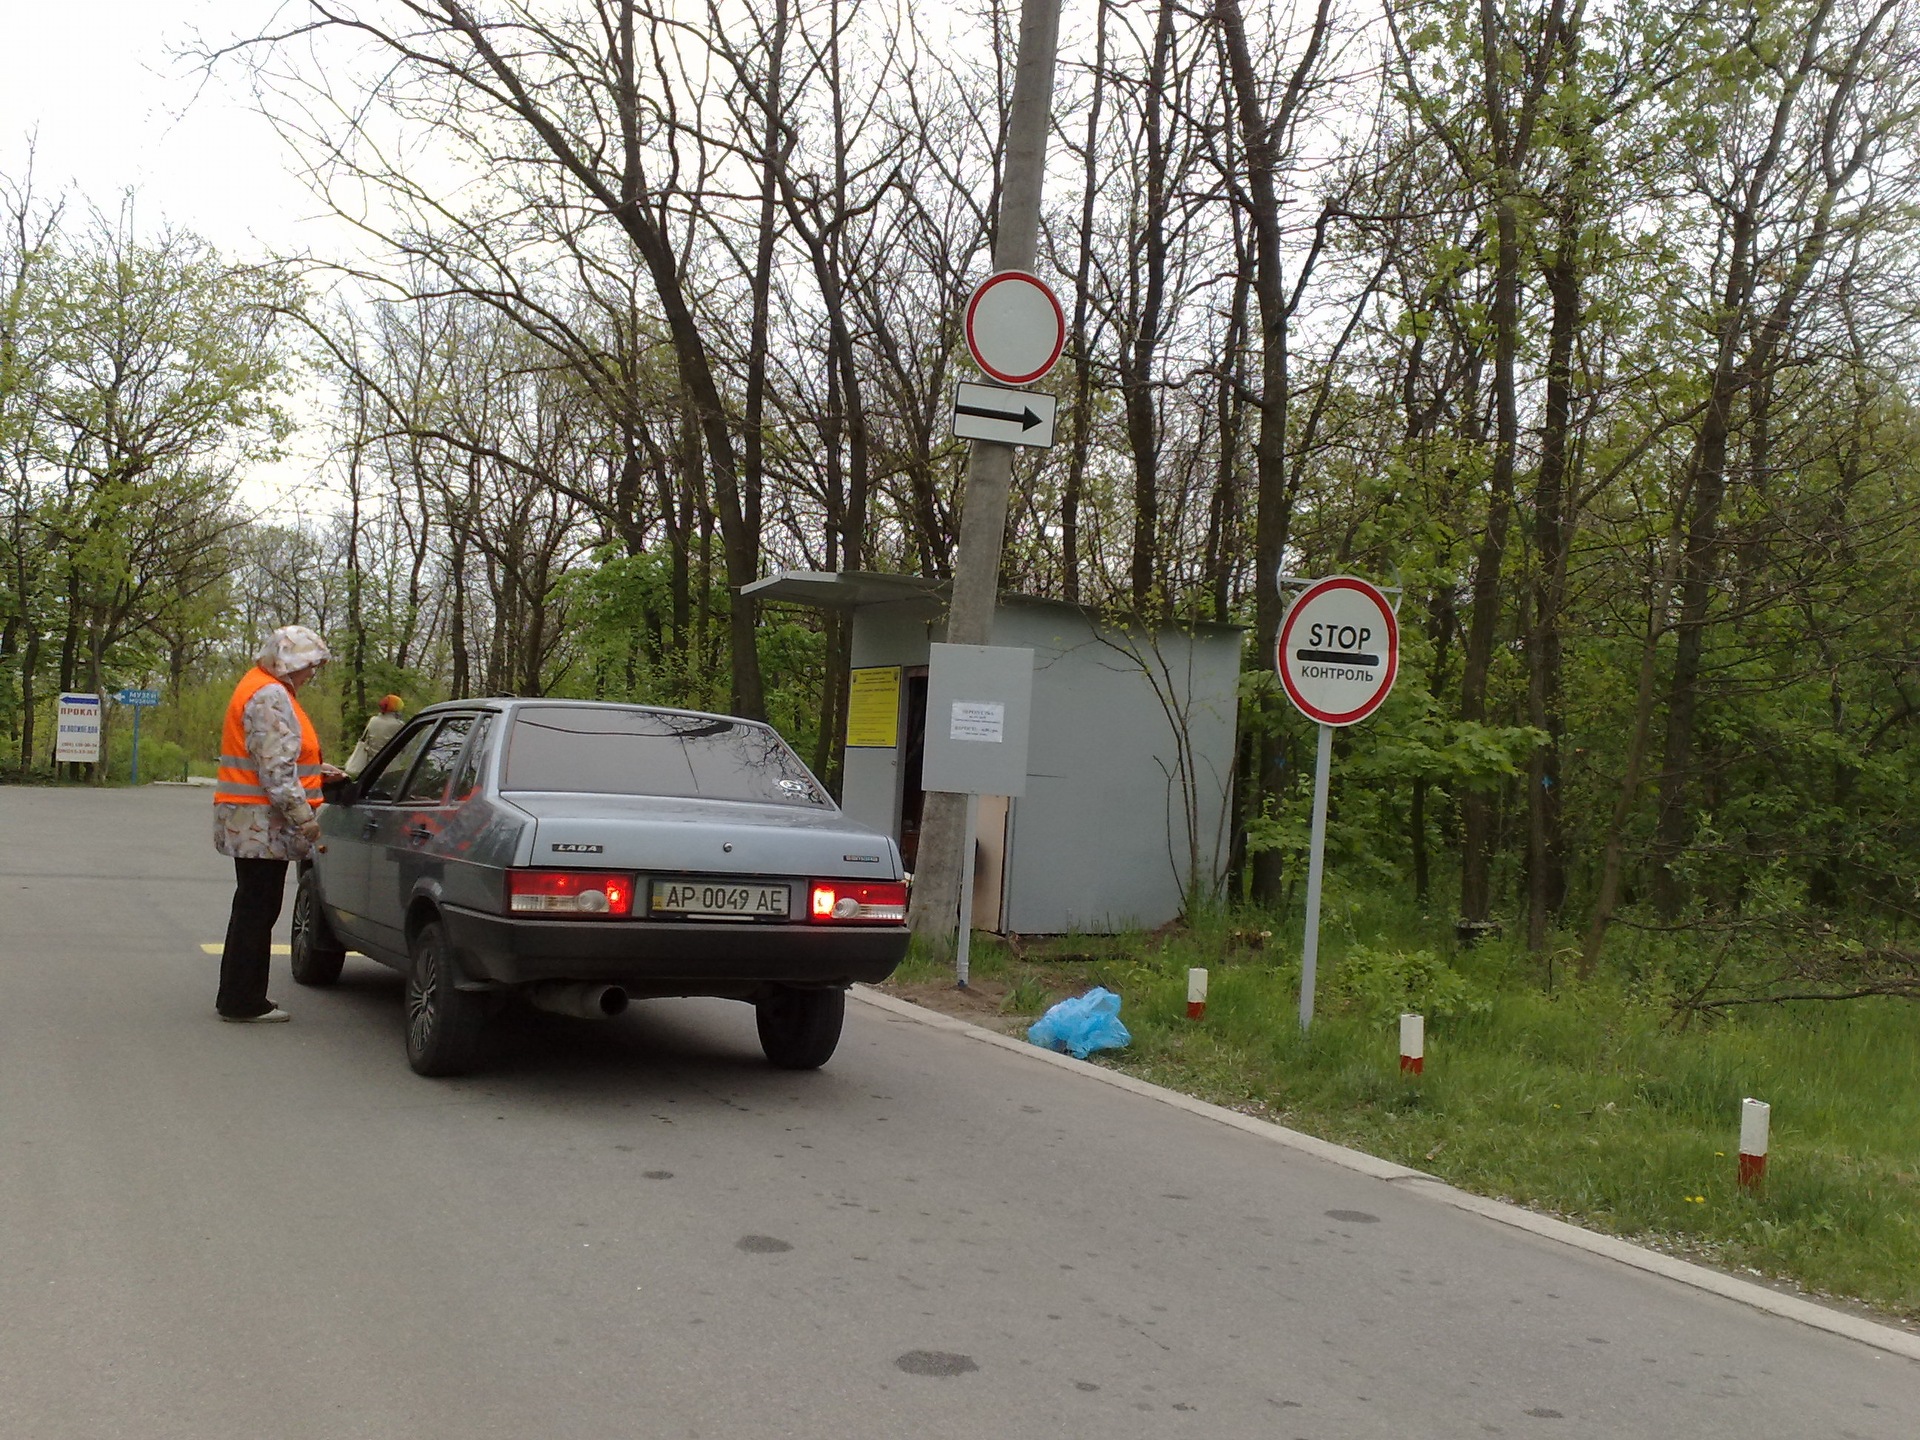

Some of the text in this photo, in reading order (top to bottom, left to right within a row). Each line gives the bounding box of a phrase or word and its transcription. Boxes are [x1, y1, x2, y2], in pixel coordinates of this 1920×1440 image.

[1309, 623, 1371, 650] STOP
[1301, 666, 1374, 682] КОНТРОЛЬ
[60, 707, 98, 716] ПРОКАТ
[557, 844, 597, 852] LADA
[666, 886, 782, 911] AP 0049 AE
